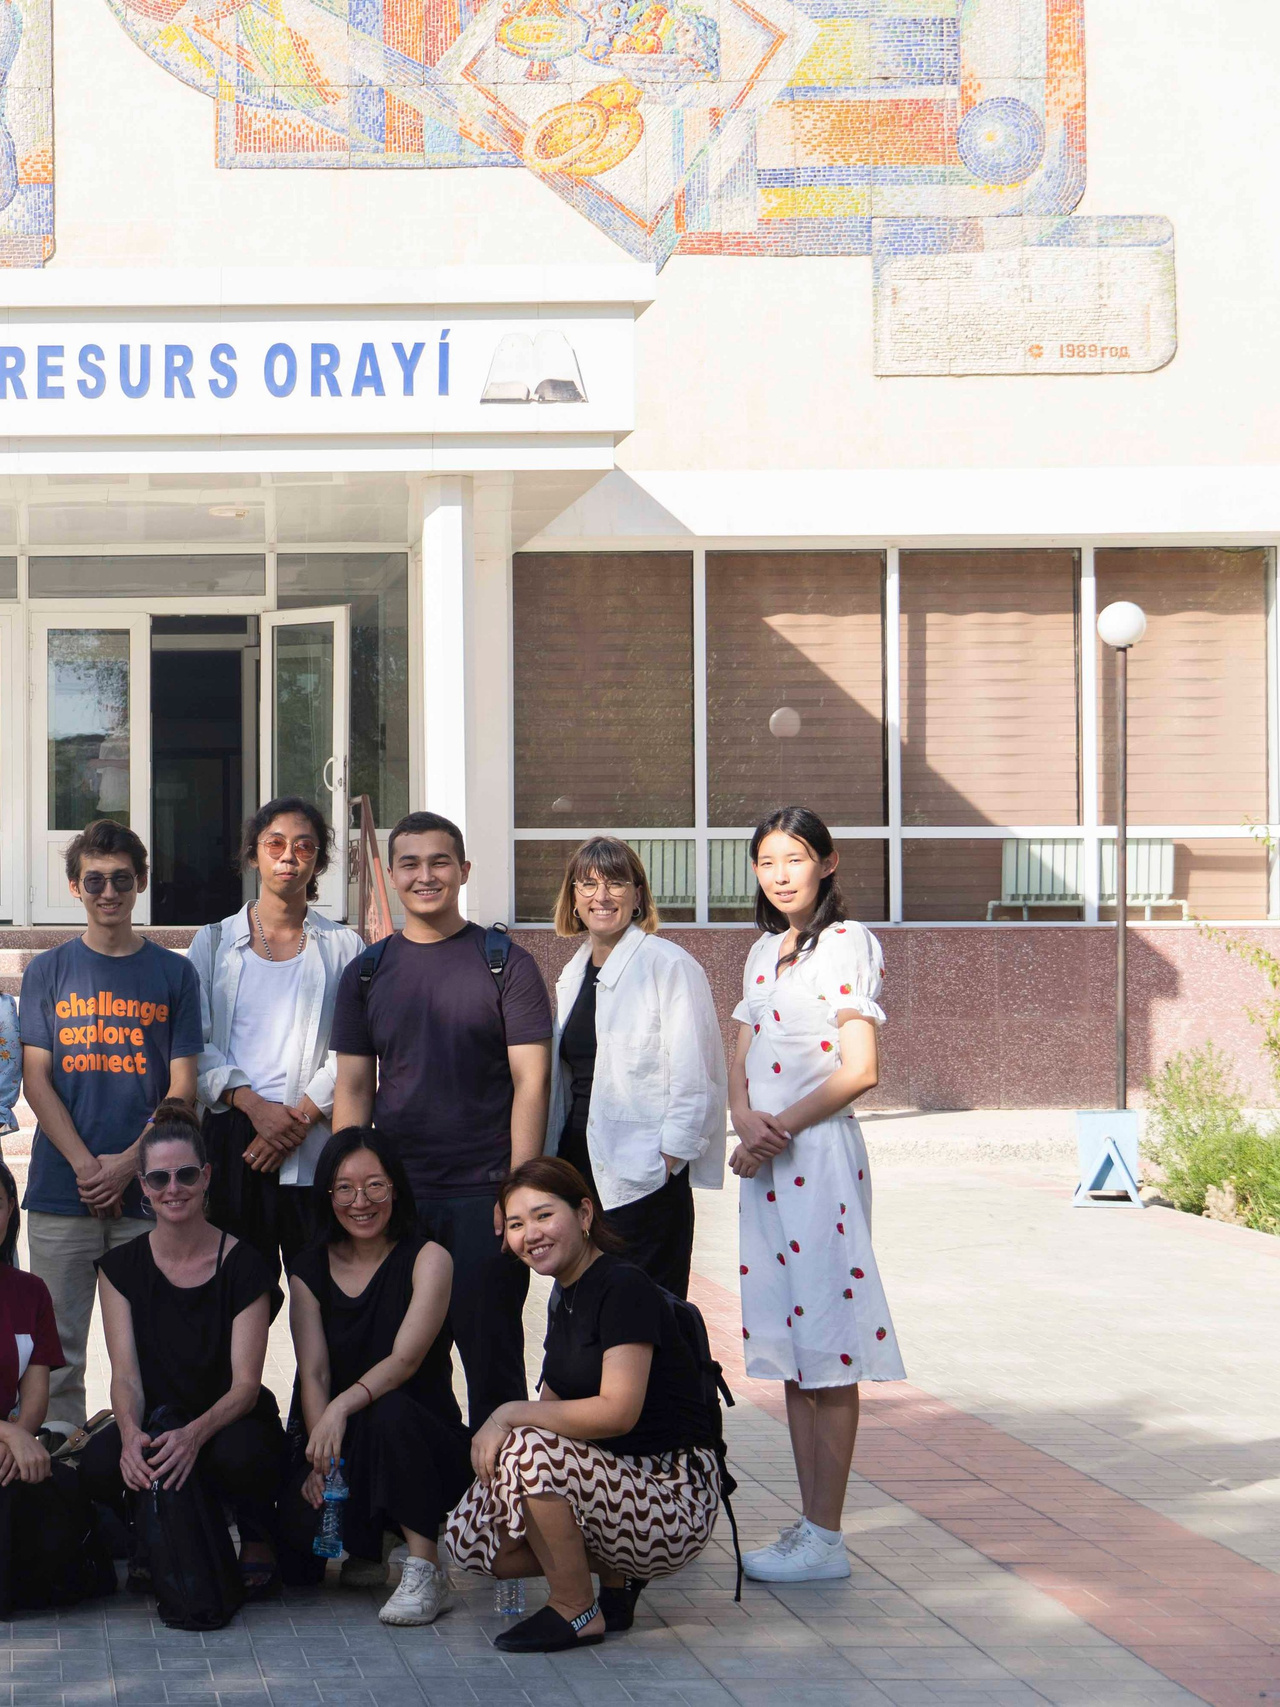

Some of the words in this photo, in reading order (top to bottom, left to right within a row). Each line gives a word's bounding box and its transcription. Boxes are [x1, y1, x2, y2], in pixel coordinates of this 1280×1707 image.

[264, 329, 451, 398] ORAYÍ
[55, 991, 169, 1026] challenge
[59, 1019, 145, 1050] explore
[62, 1052, 147, 1075] connect
